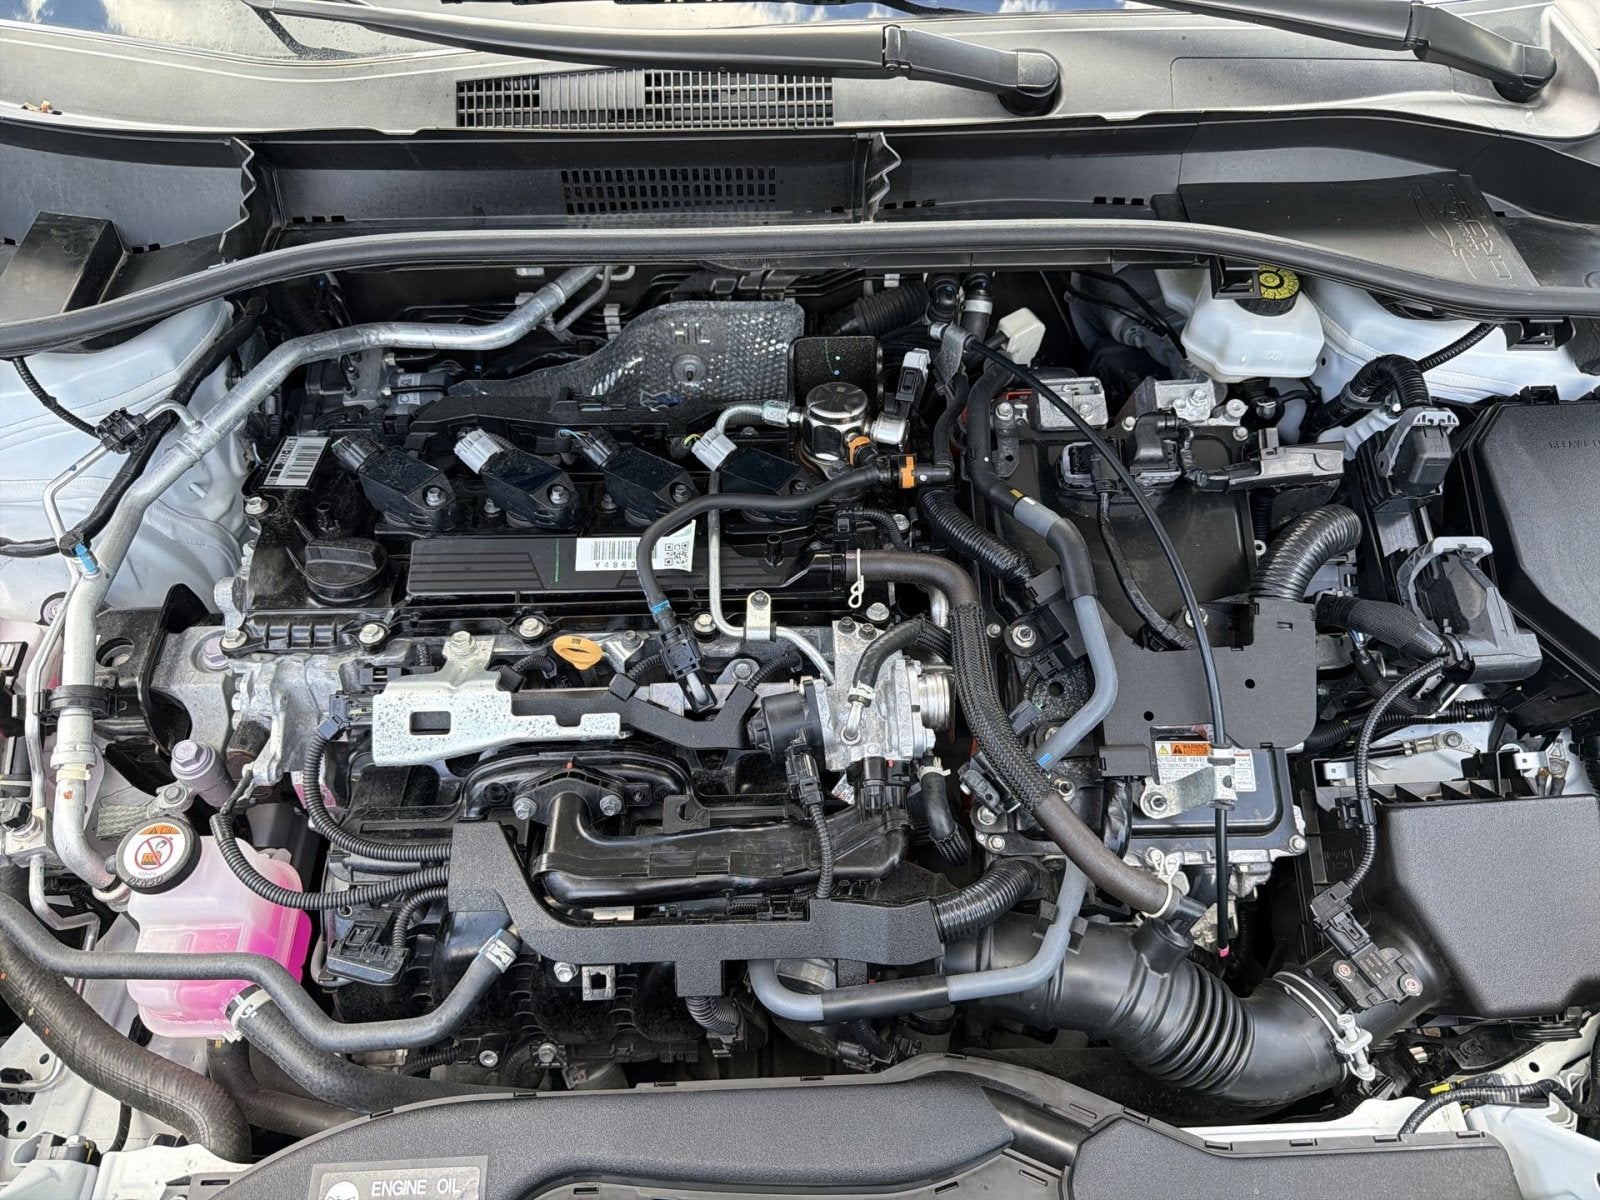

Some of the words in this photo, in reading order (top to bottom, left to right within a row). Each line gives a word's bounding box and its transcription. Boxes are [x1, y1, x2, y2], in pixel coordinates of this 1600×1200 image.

[127, 875, 164, 888] DENSO
[371, 1179, 428, 1197] ENGINE
[436, 1178, 462, 1195] OIL
